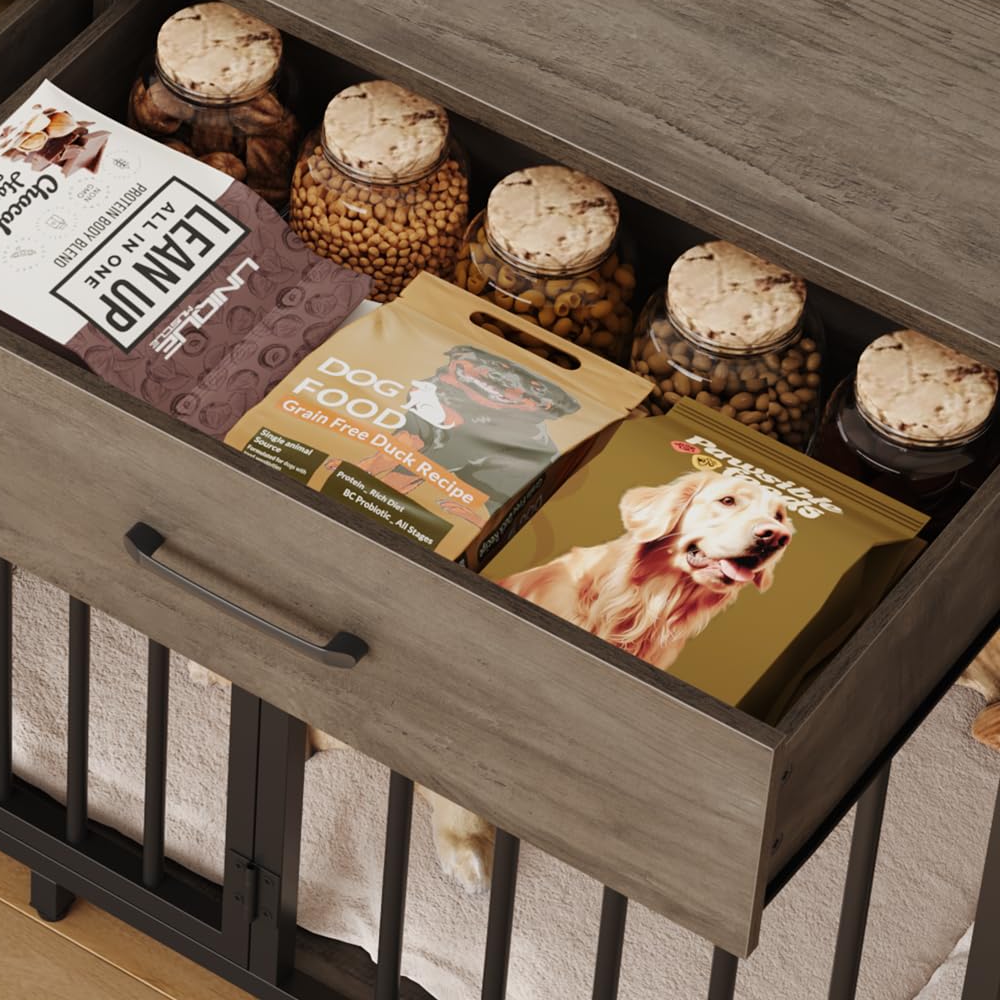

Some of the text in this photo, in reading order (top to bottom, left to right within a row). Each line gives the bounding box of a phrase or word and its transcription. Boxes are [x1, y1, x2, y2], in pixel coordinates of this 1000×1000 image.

[77, 183, 95, 199] GMO
[84, 187, 101, 203] NON
[53, 182, 148, 269] PROTEIN BODY BLEND
[84, 201, 175, 289] ALL IN ONE
[99, 204, 230, 332] LEAN UP
[149, 305, 195, 349] MUSCLE
[153, 257, 260, 361] UNIQUE
[293, 377, 407, 430] FOOD
[317, 356, 405, 399] DOG
[253, 436, 282, 453] Source
[260, 429, 314, 456] Single animal
[282, 399, 475, 505] Grain Free Duck Recipe
[370, 488, 388, 504] Rich
[387, 496, 405, 513] Diet
[685, 435, 843, 515] Pawsible
[342, 488, 355, 501] BC
[395, 518, 408, 532] All
[407, 524, 434, 546] Stages
